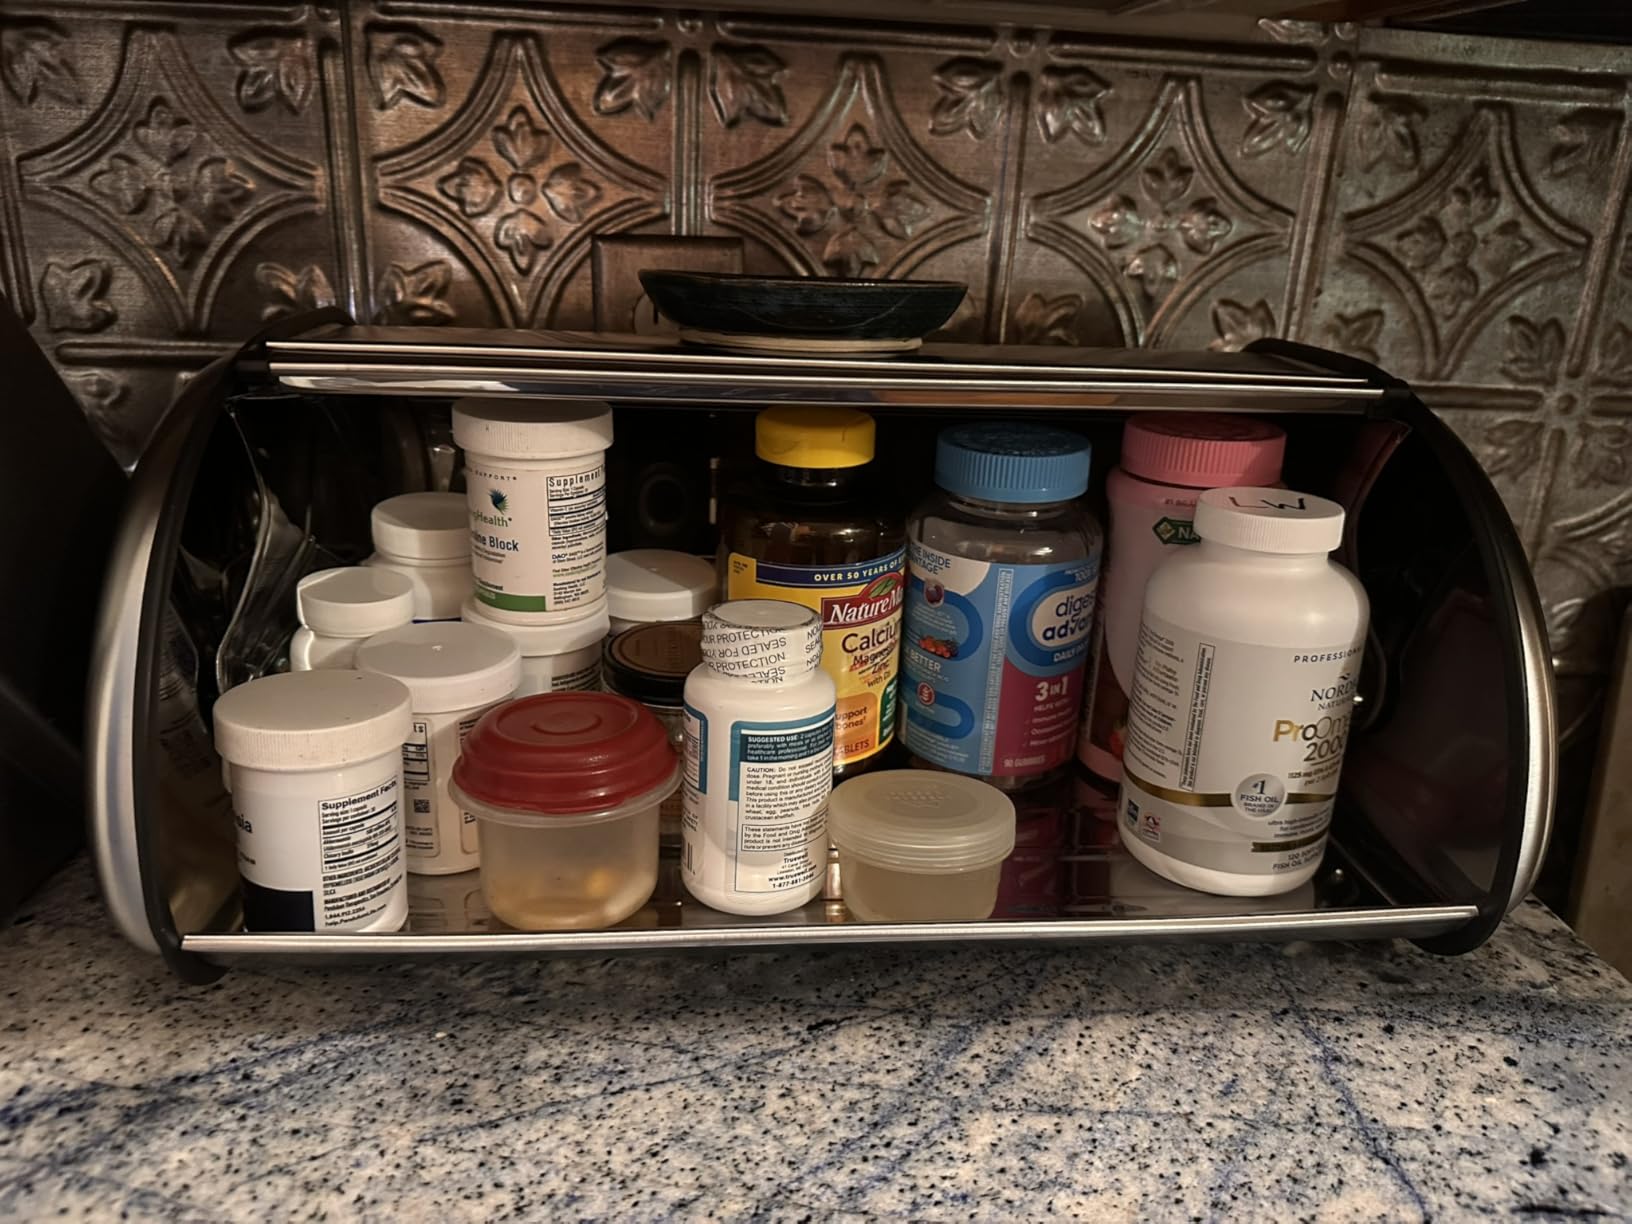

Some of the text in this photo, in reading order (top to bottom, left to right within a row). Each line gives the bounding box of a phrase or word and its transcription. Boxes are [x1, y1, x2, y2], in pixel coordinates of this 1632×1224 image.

[488, 536, 519, 553] Block
[922, 549, 952, 569] INSIDE
[814, 573, 843, 582] OVER
[847, 572, 860, 580] 50
[862, 564, 888, 577] YEARS
[718, 647, 739, 658] FOR
[742, 637, 787, 656] SEALED
[716, 652, 786, 672] PROTECTION
[910, 650, 941, 672] BETTER
[1035, 681, 1049, 701] 3
[1062, 676, 1068, 695] 1
[322, 789, 379, 810] Supplement
[380, 780, 397, 795] Facts
[1240, 793, 1280, 803] FISH OIL
